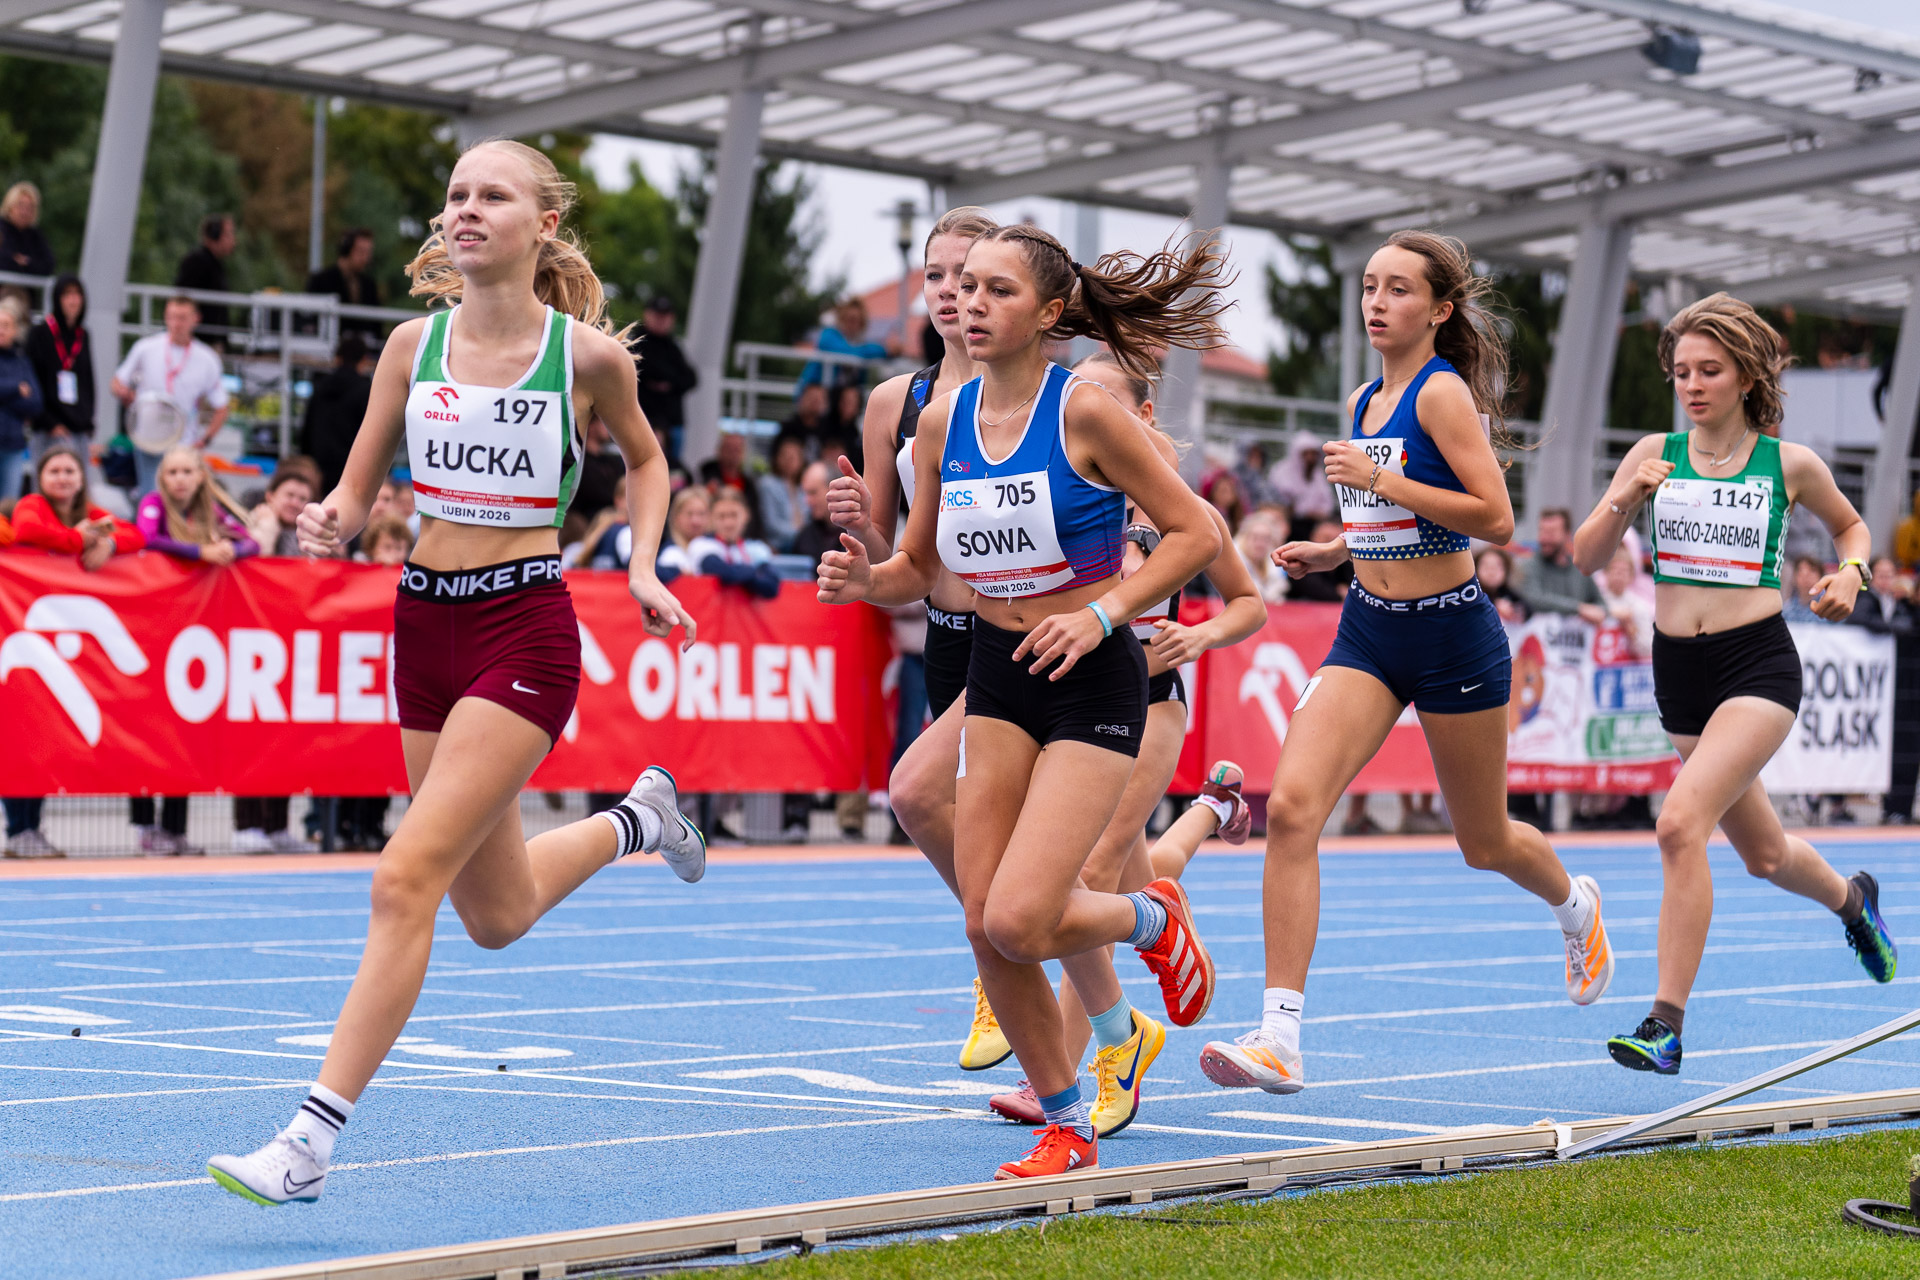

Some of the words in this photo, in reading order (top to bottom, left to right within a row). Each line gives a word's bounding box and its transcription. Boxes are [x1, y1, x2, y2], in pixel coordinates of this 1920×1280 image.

[424, 410, 459, 423] ORLEN
[494, 398, 547, 425] 197
[425, 439, 535, 478] ŁUCKA
[948, 459, 970, 473] esa
[1366, 445, 1391, 465] 959
[995, 481, 1036, 508] 705
[1712, 488, 1765, 510] 1147
[442, 505, 476, 518] LUBIN
[479, 509, 511, 521] 2026
[957, 527, 1036, 557] SOWA
[1367, 535, 1386, 543] 2026
[1659, 516, 1760, 549] CHEĆKO-ZAREMBA
[435, 565, 516, 597] NIKE
[522, 560, 562, 583] PR
[1682, 566, 1703, 576] LUBIN
[1706, 569, 1728, 578] 2026
[982, 584, 1009, 593] LUBIN
[1010, 581, 1036, 592] 2026
[1417, 584, 1478, 611] PRO
[926, 605, 967, 631] NIKE
[164, 623, 400, 724] ORLE
[628, 637, 836, 724] ORLEN
[1802, 659, 1887, 700] DOLNY
